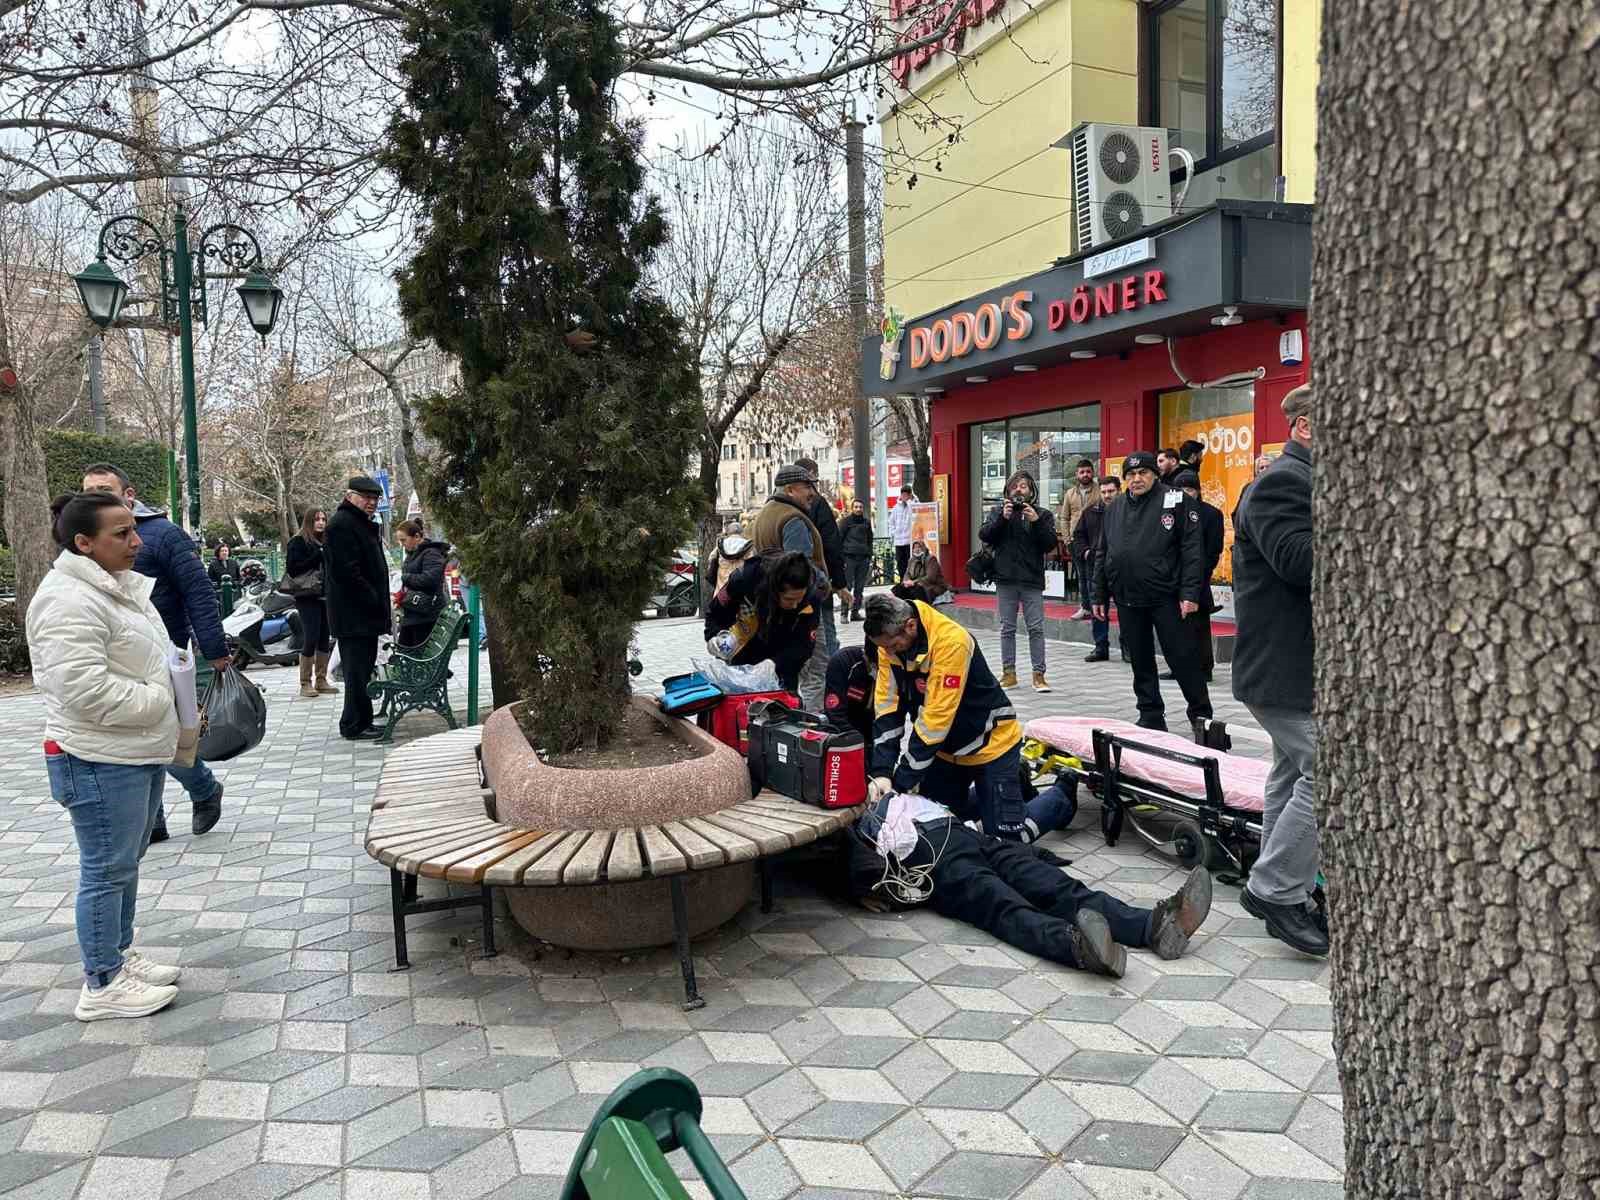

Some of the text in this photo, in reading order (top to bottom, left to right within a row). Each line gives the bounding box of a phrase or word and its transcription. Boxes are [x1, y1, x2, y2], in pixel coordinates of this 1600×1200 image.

[1151, 135, 1160, 173] VESTEL
[910, 270, 1168, 369] DODO'S DÖNER
[1197, 424, 1252, 456] DODO
[829, 755, 841, 802] SCHILLER
